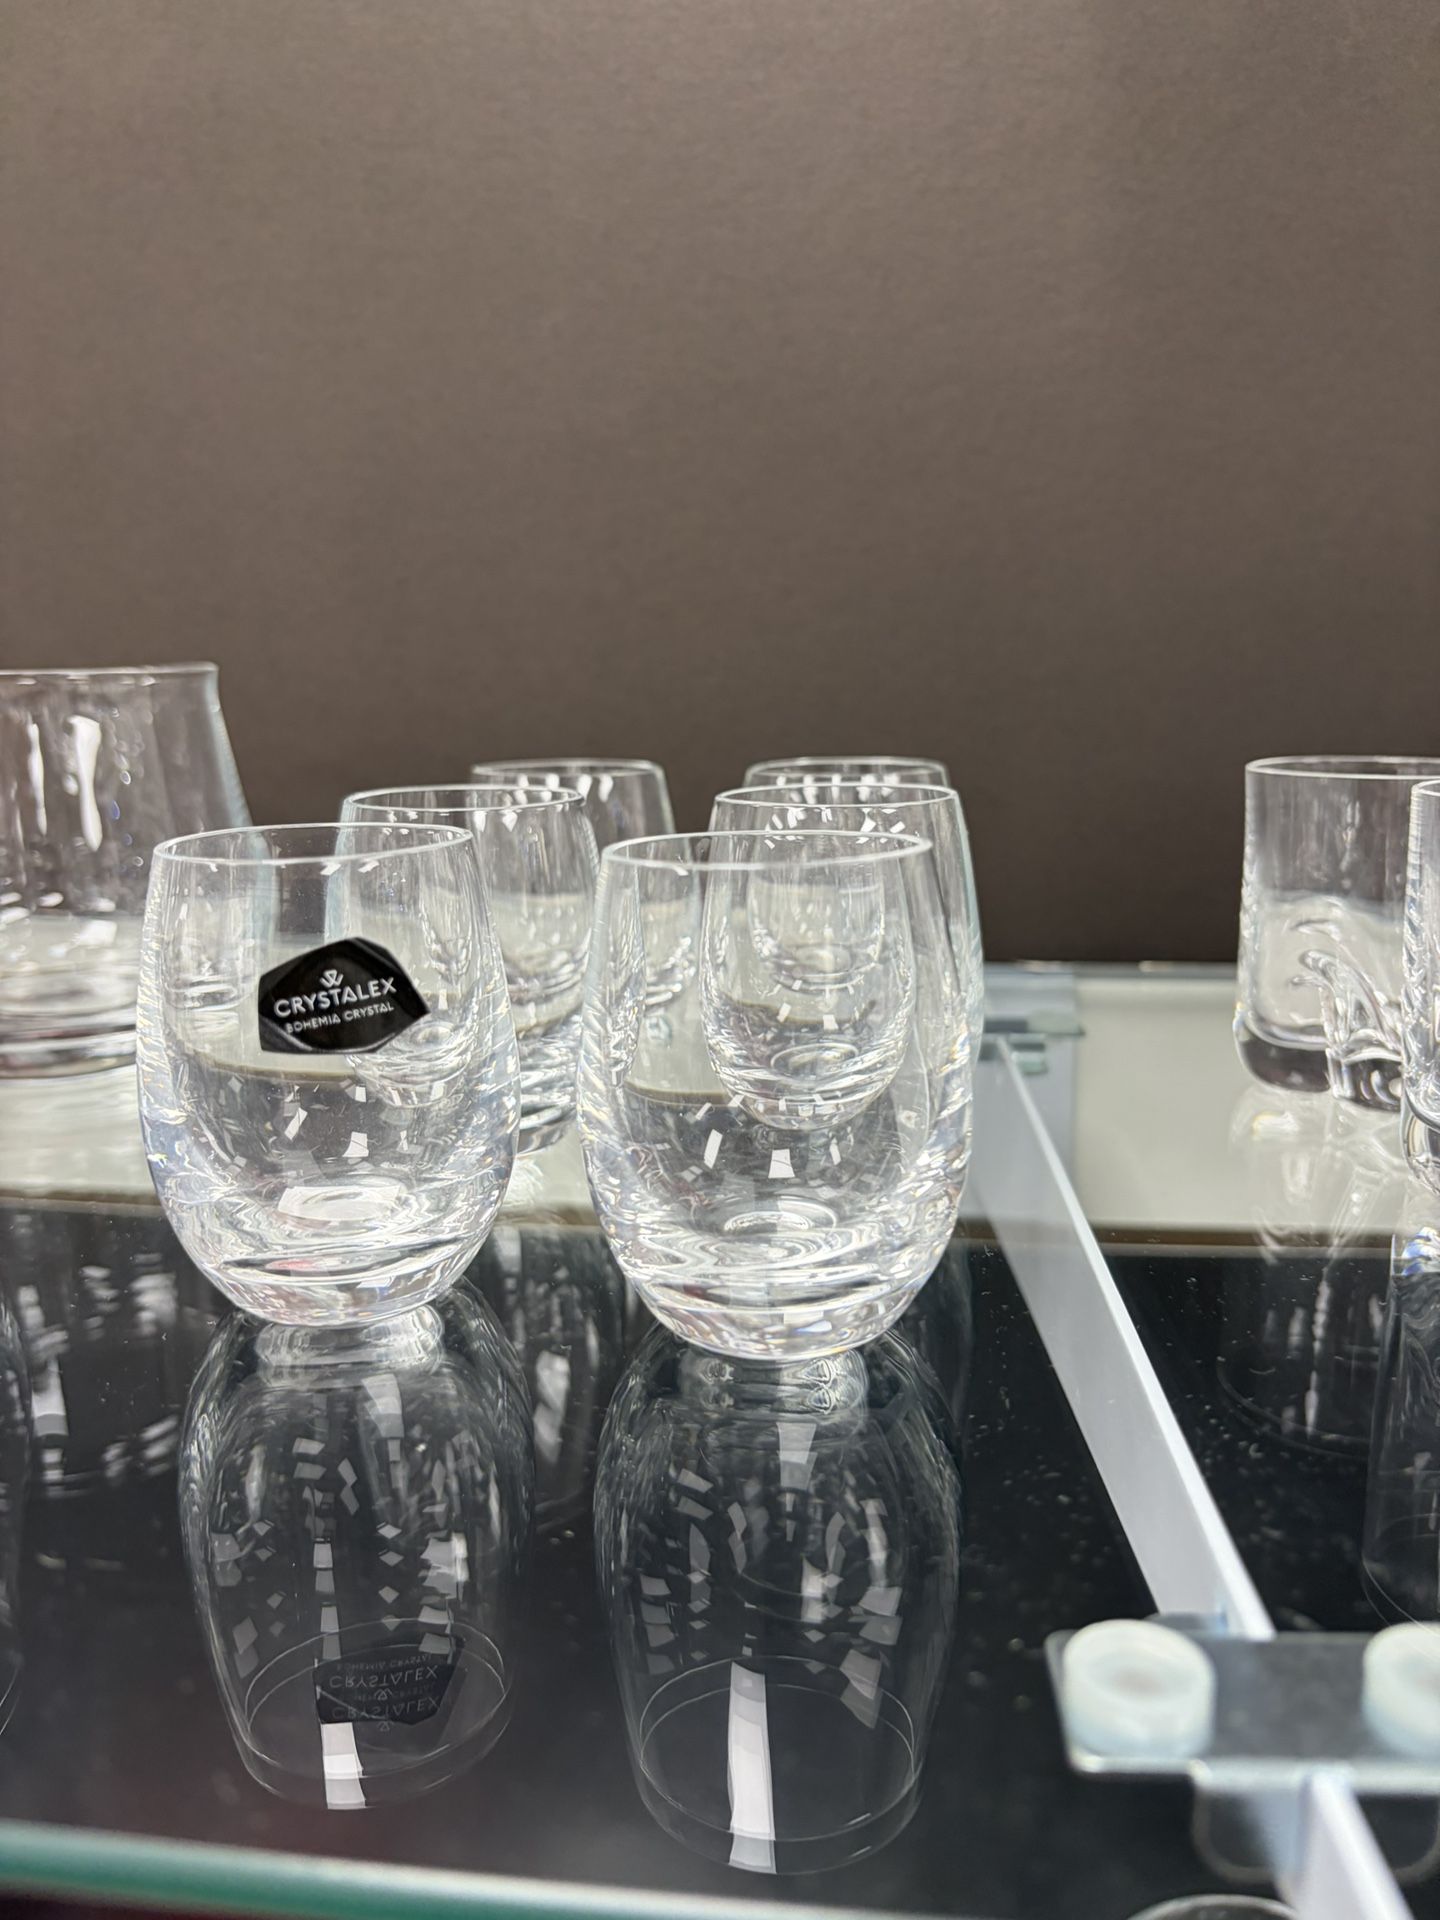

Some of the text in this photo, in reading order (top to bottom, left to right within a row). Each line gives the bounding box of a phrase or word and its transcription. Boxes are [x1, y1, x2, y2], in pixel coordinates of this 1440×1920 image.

[273, 977, 397, 1018] CRYSTALEX
[284, 1001, 395, 1034] BOHEMIA CRYSTAL
